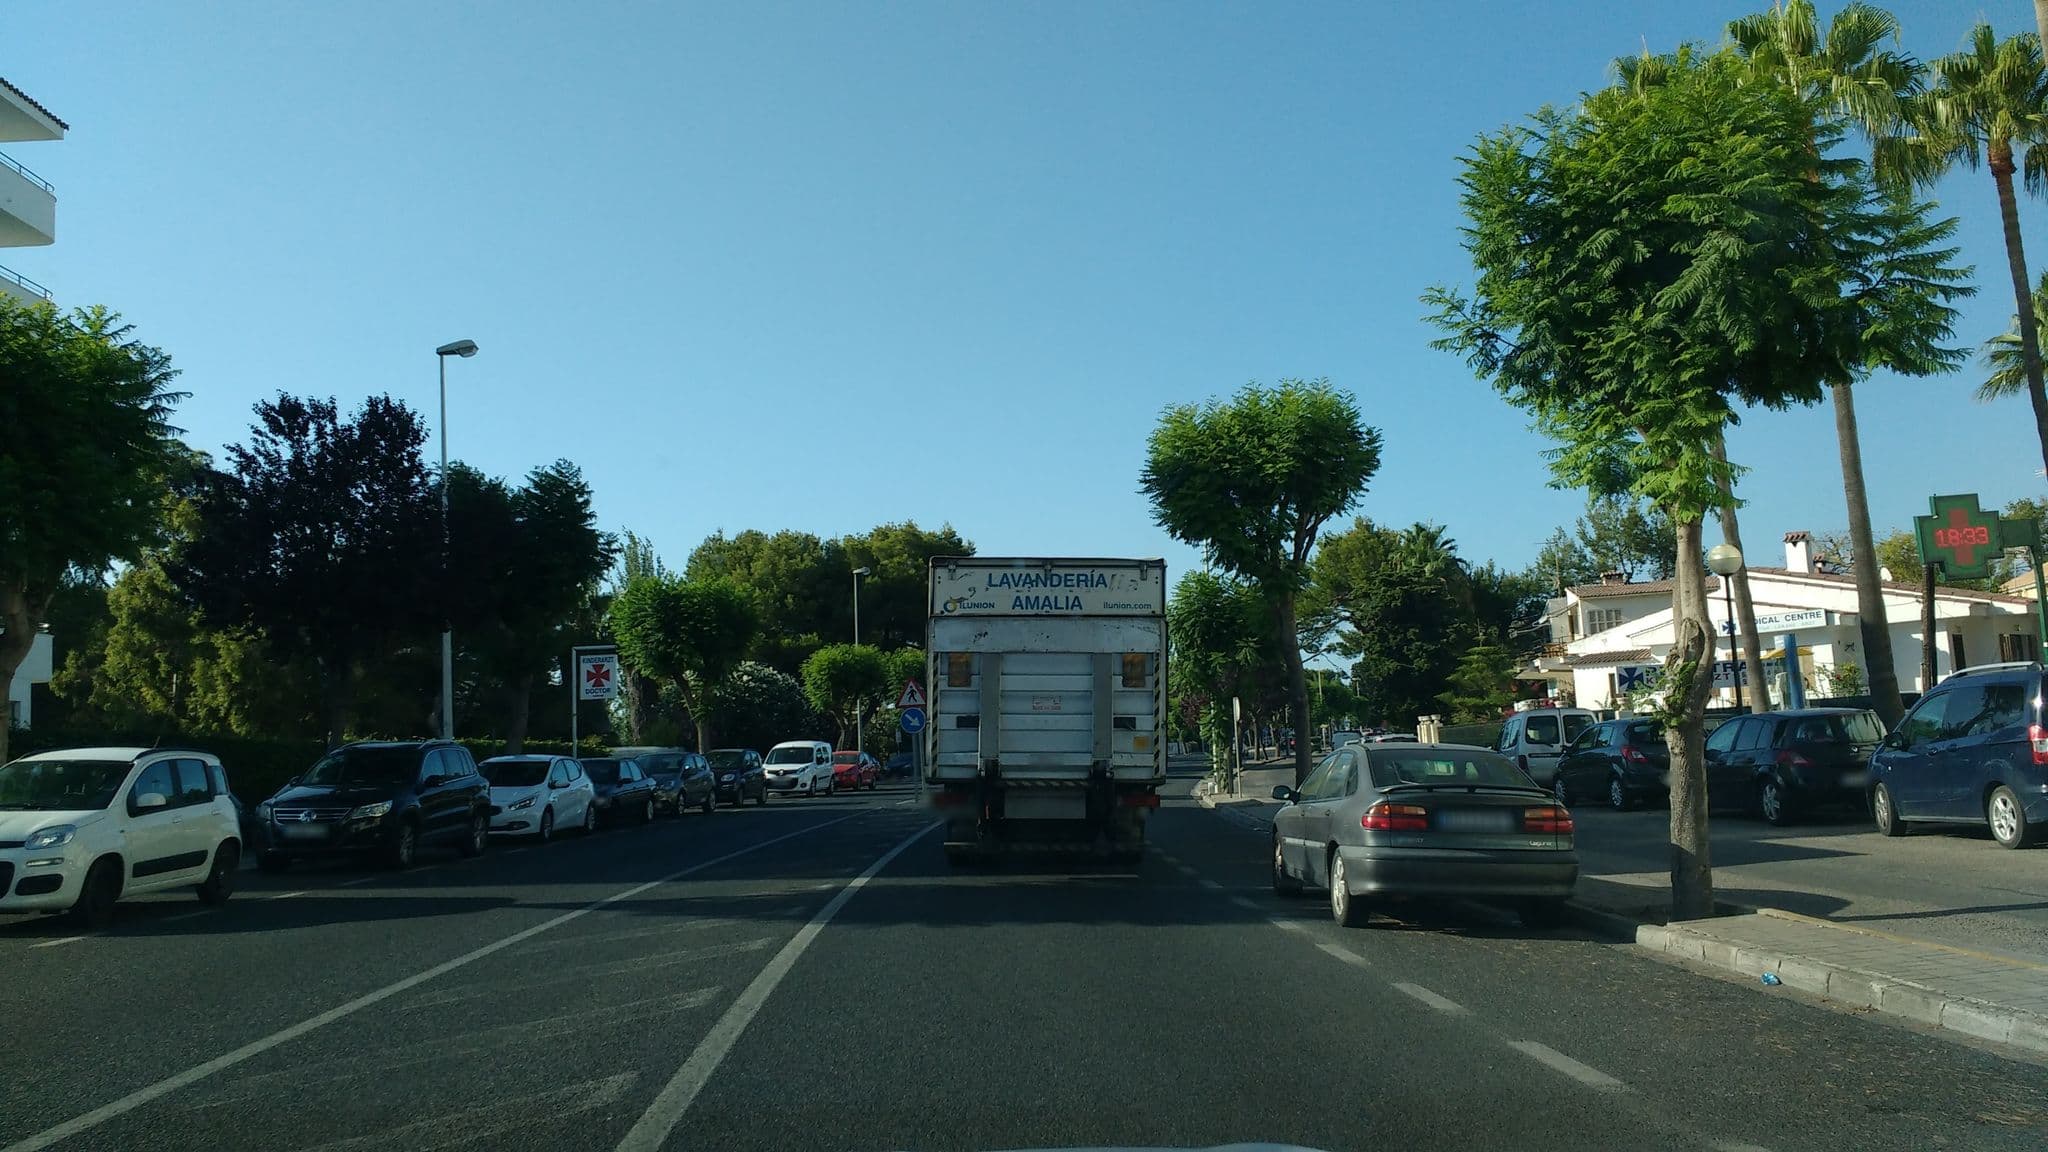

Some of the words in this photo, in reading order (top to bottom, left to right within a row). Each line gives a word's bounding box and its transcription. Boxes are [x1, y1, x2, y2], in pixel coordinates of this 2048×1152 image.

[1935, 525, 1989, 547] 18:33
[987, 569, 1108, 588] LAVANDERÍA
[959, 601, 995, 609] ILUNION
[1011, 595, 1083, 610] AMALIA
[1103, 601, 1152, 609] ilunion.com
[1784, 610, 1822, 622] CENTRE
